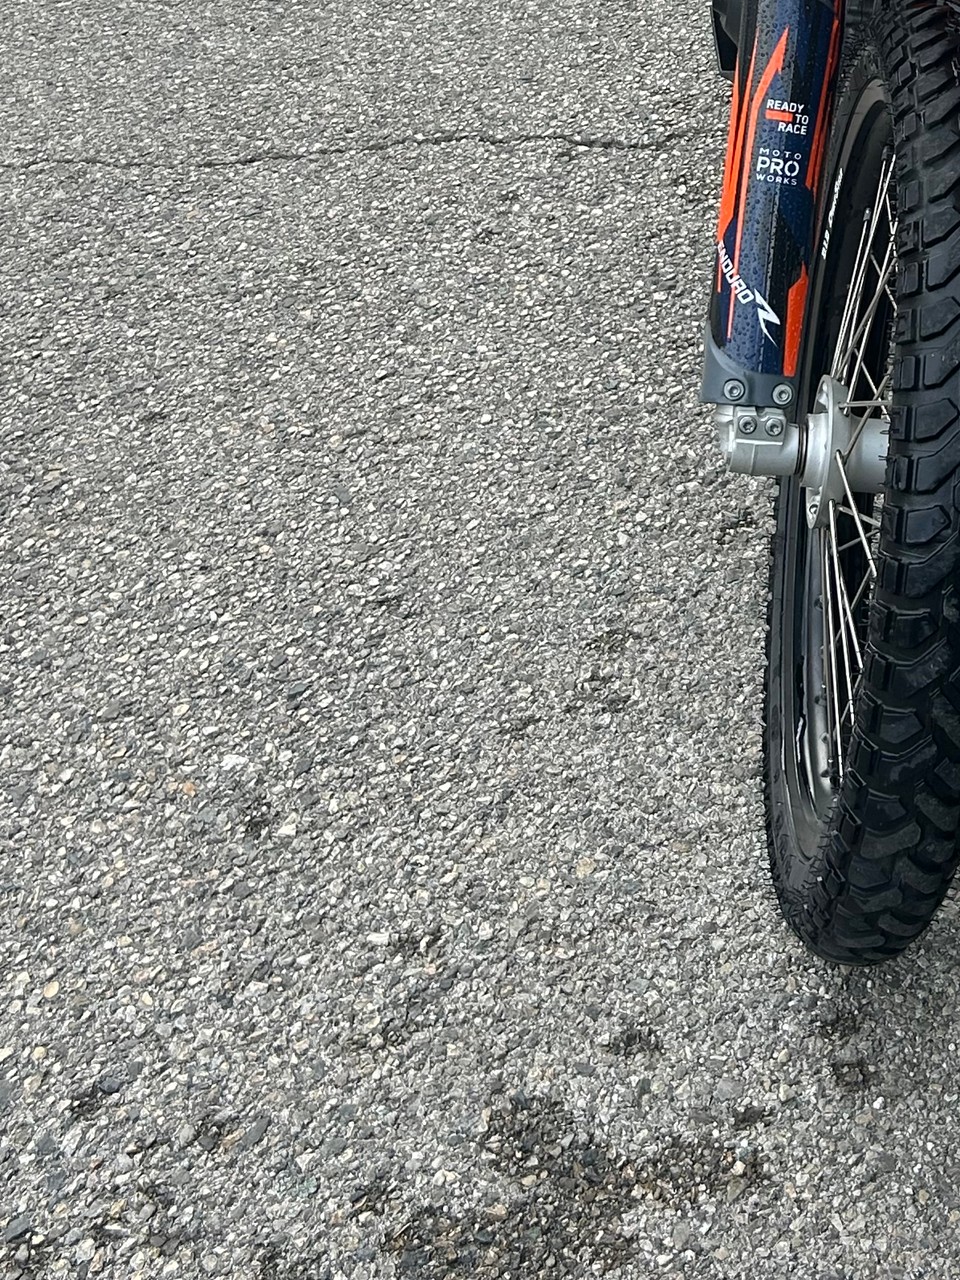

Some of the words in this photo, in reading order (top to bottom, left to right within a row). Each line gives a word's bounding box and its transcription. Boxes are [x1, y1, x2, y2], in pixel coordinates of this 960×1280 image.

[766, 99, 805, 113] READY
[795, 113, 809, 125] TO
[777, 121, 808, 136] RACE
[759, 147, 802, 160] MOTO
[756, 155, 799, 177] PRO
[755, 173, 797, 186] WORKS
[717, 239, 755, 305] ENDURO
